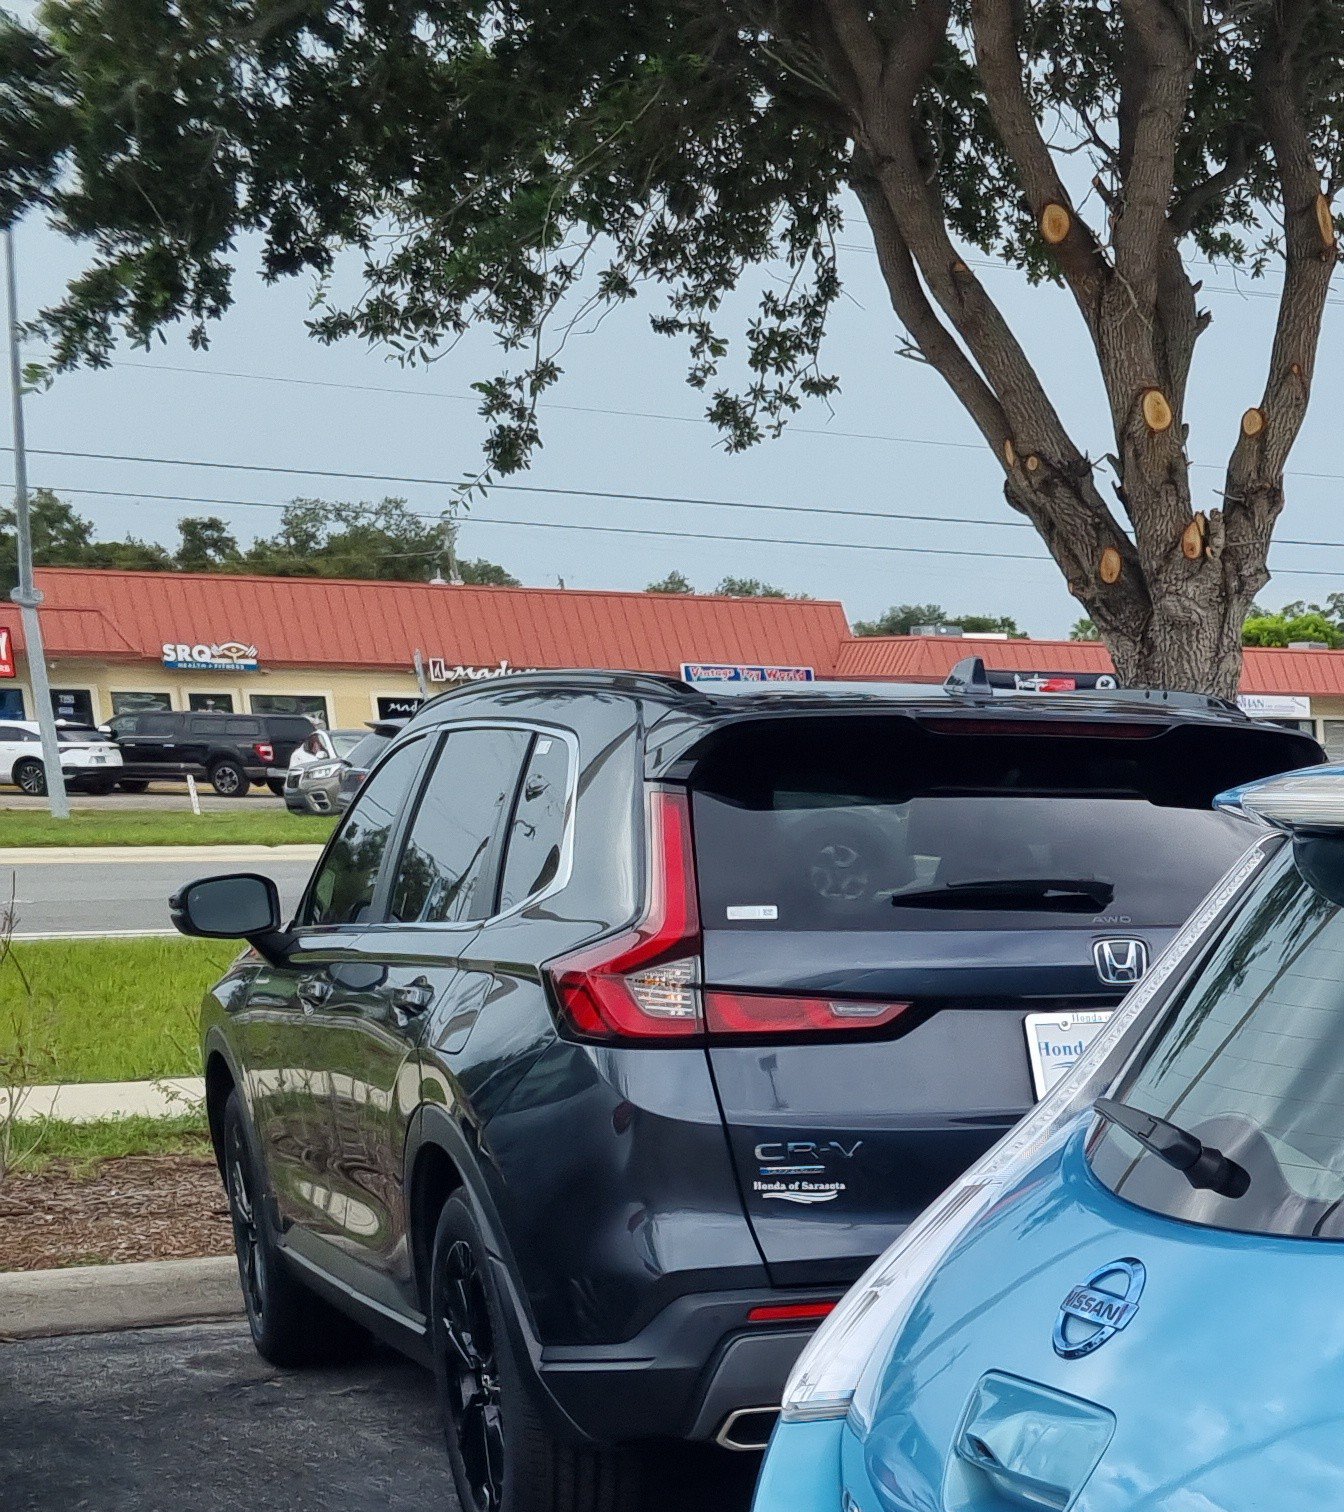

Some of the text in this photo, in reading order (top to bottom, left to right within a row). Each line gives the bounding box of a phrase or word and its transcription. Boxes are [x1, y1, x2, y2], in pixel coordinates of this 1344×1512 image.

[163, 644, 211, 662] SRQ
[1092, 916, 1132, 924] AWD
[1072, 1013, 1101, 1023] Honda
[755, 1141, 863, 1161] CR-V
[753, 1181, 846, 1191] Honda of Sarasota
[1066, 1290, 1121, 1321] NISSAN
